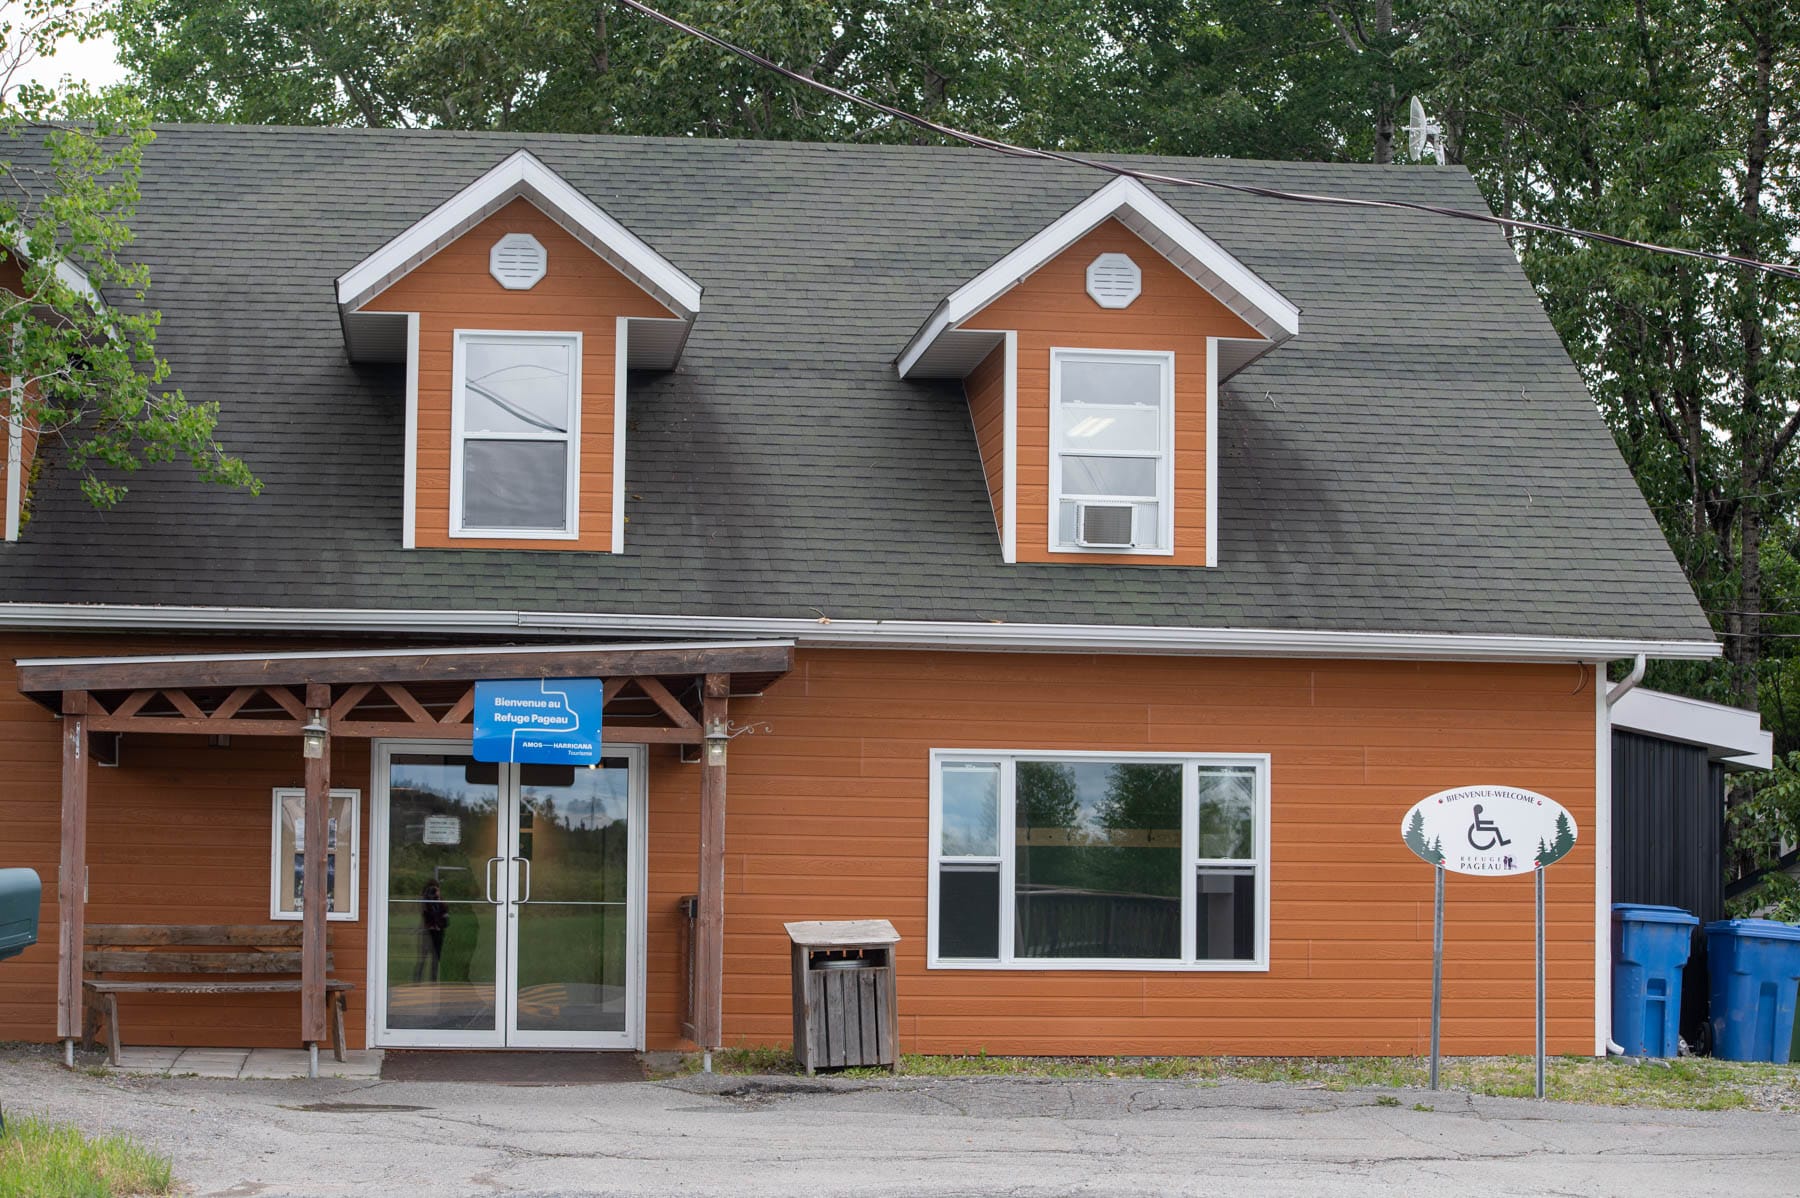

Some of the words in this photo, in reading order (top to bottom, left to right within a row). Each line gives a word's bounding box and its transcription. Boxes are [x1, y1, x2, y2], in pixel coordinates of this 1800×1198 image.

[494, 697, 547, 709] Bienvenue
[548, 700, 561, 709] au
[494, 713, 530, 723] Refuge
[531, 714, 569, 725] Pageau
[522, 741, 543, 749] AMOS
[553, 742, 593, 750] HARRICANA
